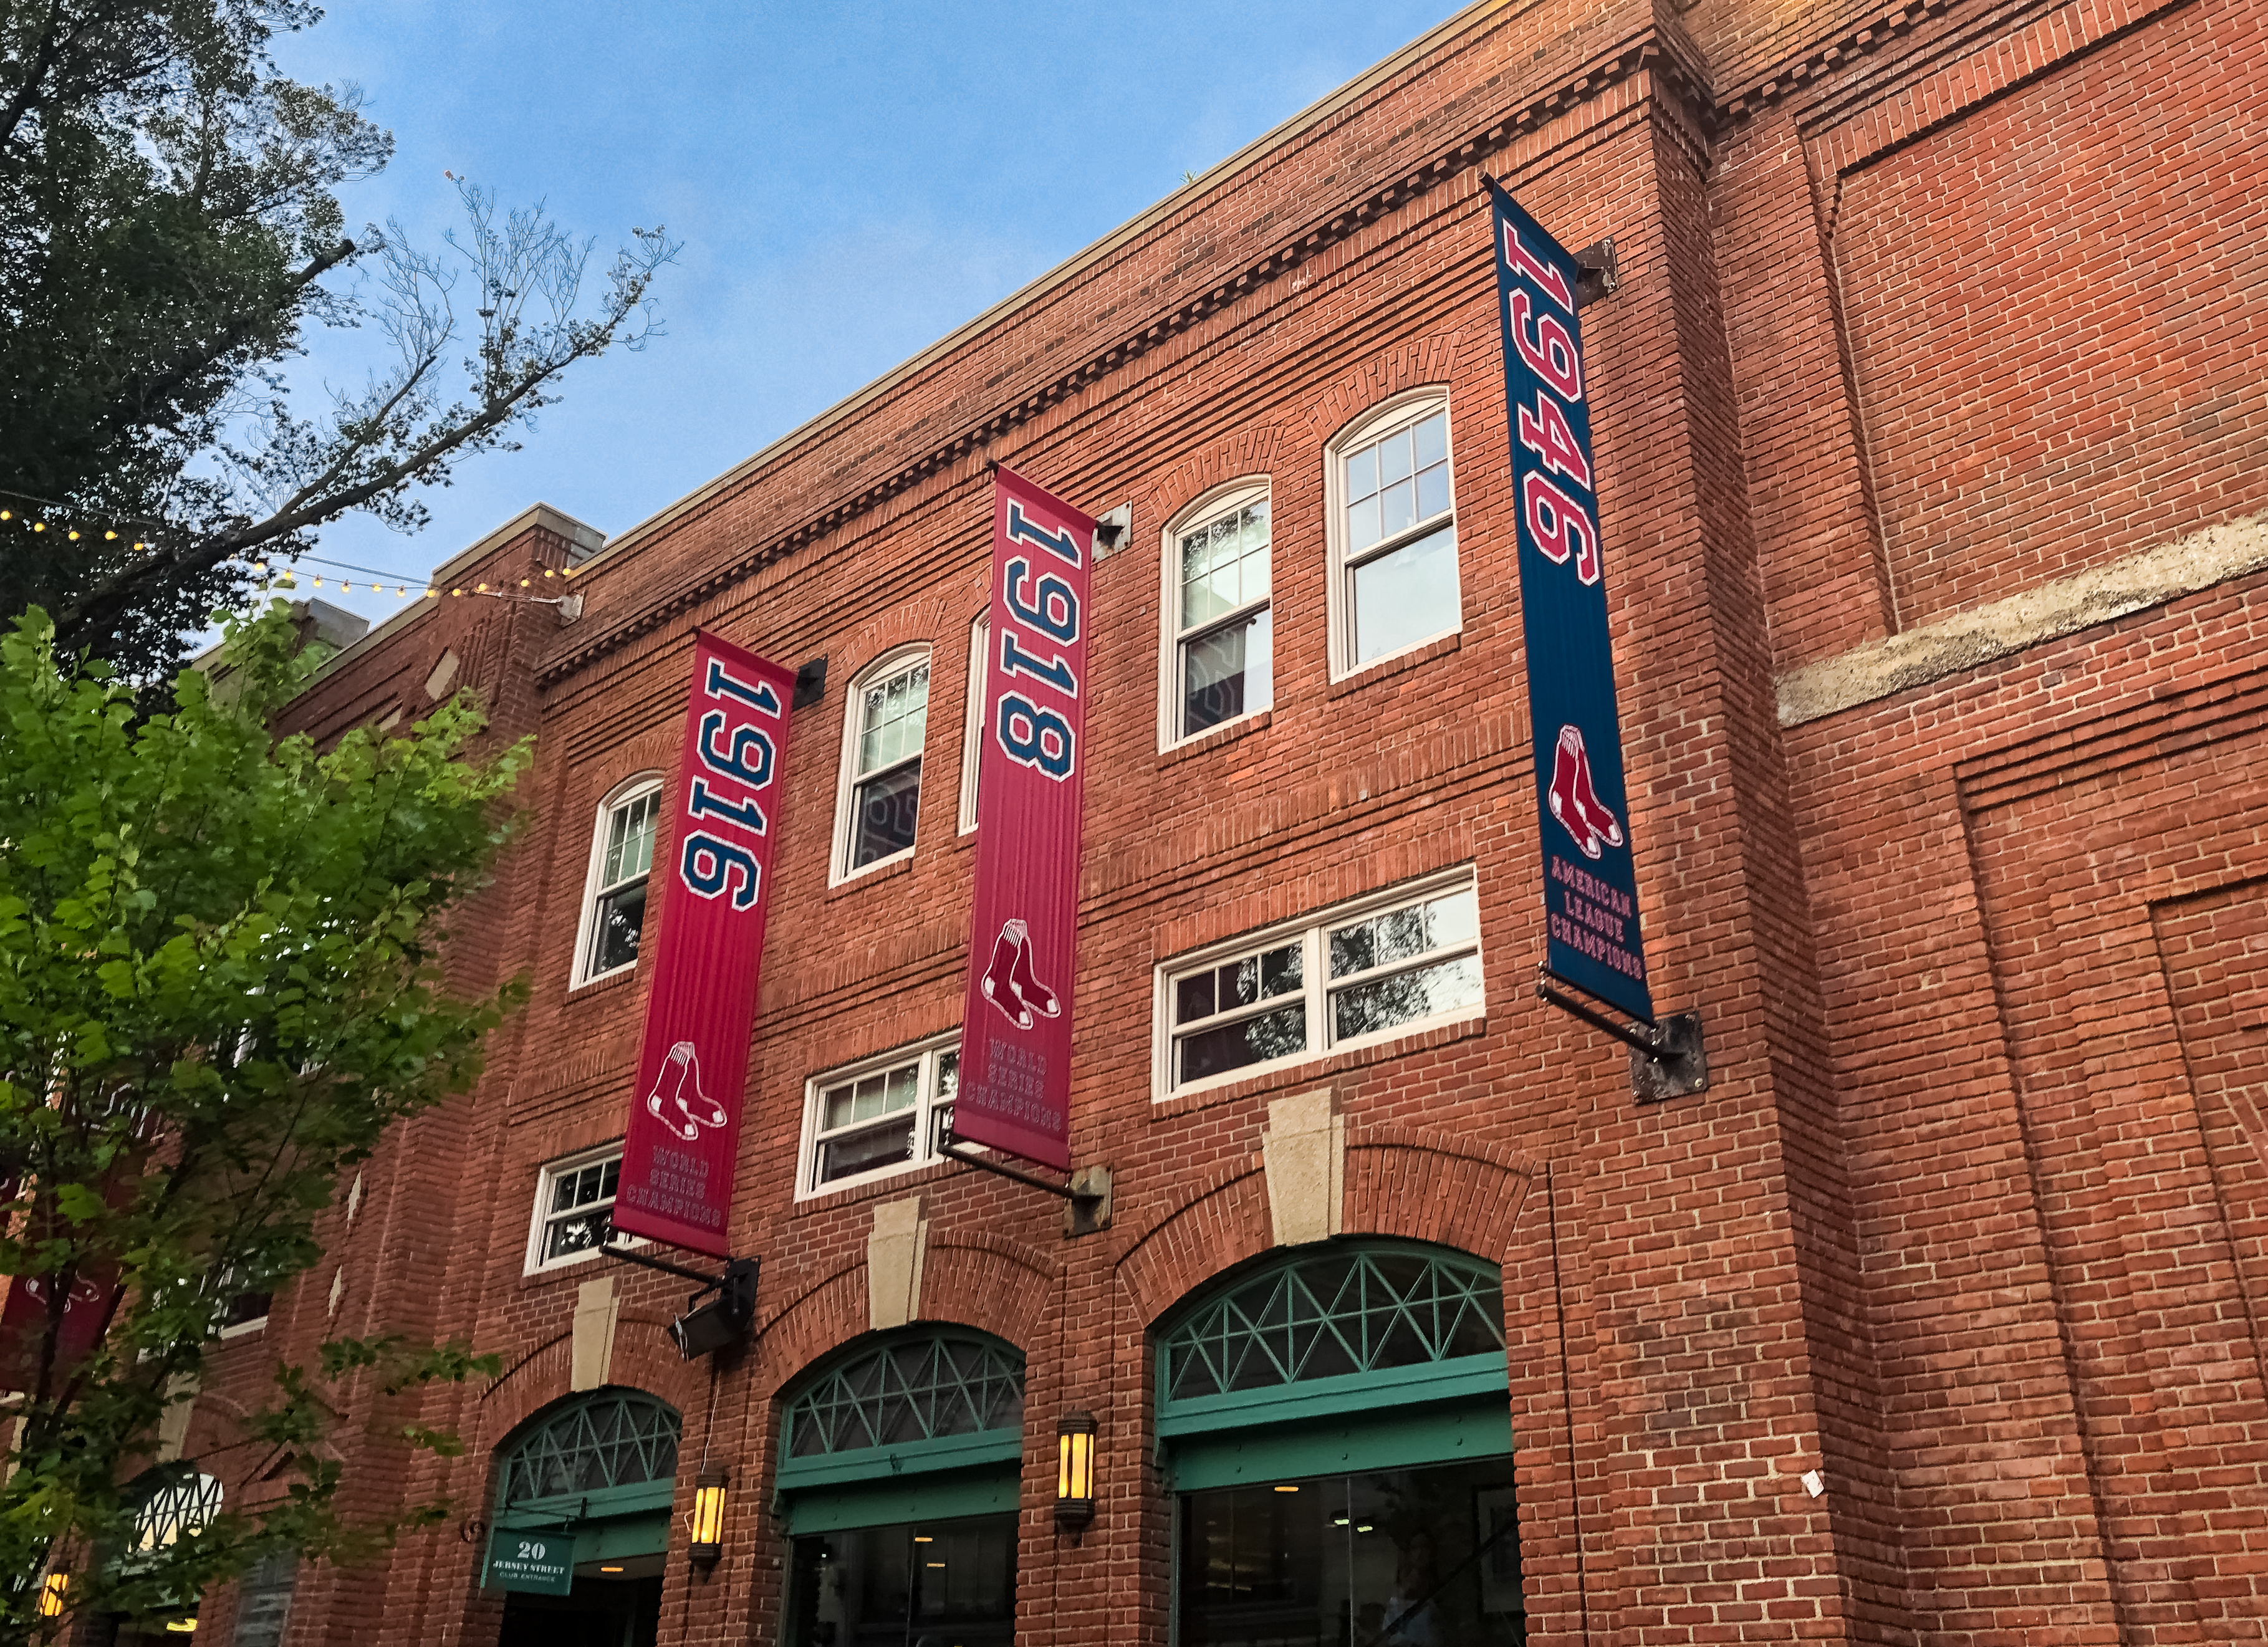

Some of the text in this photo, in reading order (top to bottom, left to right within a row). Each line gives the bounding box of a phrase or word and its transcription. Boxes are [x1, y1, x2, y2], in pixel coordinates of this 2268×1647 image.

[1502, 217, 1600, 586] 1946
[996, 497, 1082, 783] 1918
[680, 656, 782, 912] 1916
[1551, 855, 1632, 919] AMERICAN
[1564, 890, 1625, 943] LEAGUE
[1550, 913, 1643, 980] CHAMPIONS
[989, 1037, 1047, 1076] WORLD
[987, 1063, 1044, 1100] SERIES
[966, 1081, 1061, 1132] CHAMPIONS
[652, 1145, 709, 1178] WORLD
[626, 1184, 721, 1228] CHAMPIONS
[650, 1168, 706, 1200] SERIES
[493, 1560, 565, 1574] JERSEY STREET
[517, 1541, 545, 1560] 20
[499, 1571, 555, 1583] CLUB ENTRANCE
